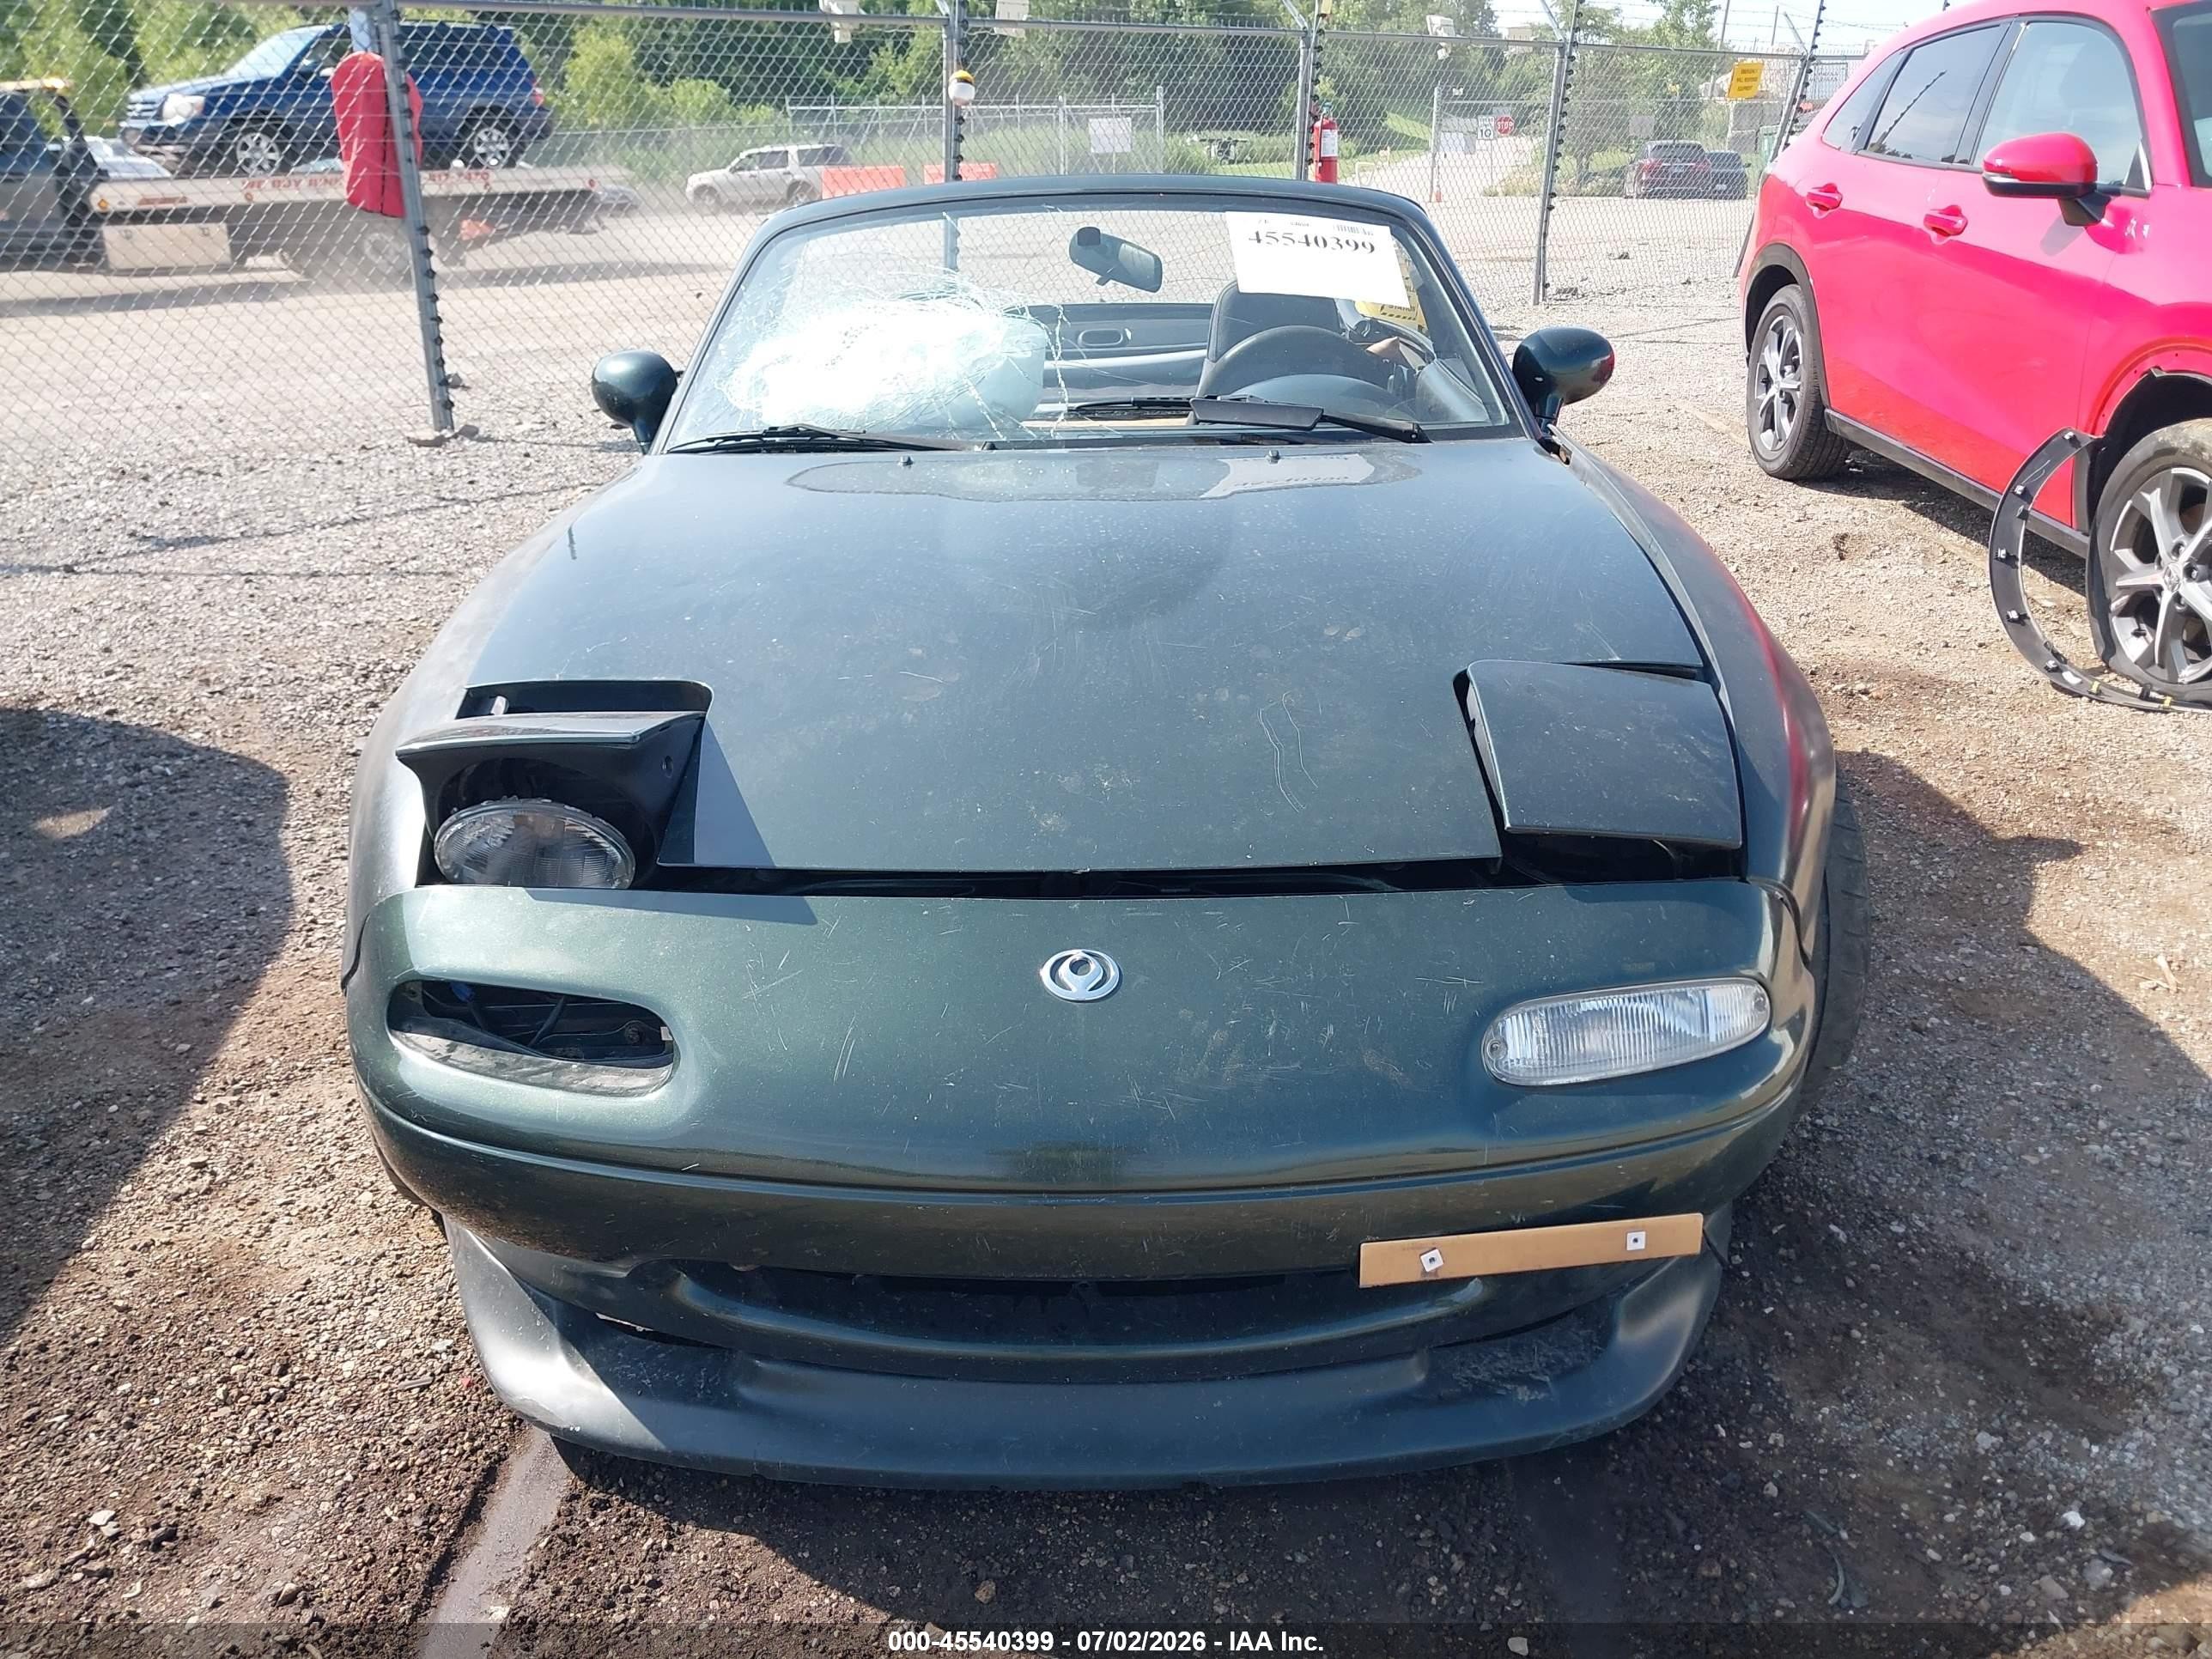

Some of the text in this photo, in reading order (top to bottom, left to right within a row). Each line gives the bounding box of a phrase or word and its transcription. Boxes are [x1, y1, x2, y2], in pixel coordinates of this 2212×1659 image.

[1497, 120, 1513, 131] STOP
[1480, 129, 1492, 137] 10
[1249, 230, 1375, 254] 45540399
